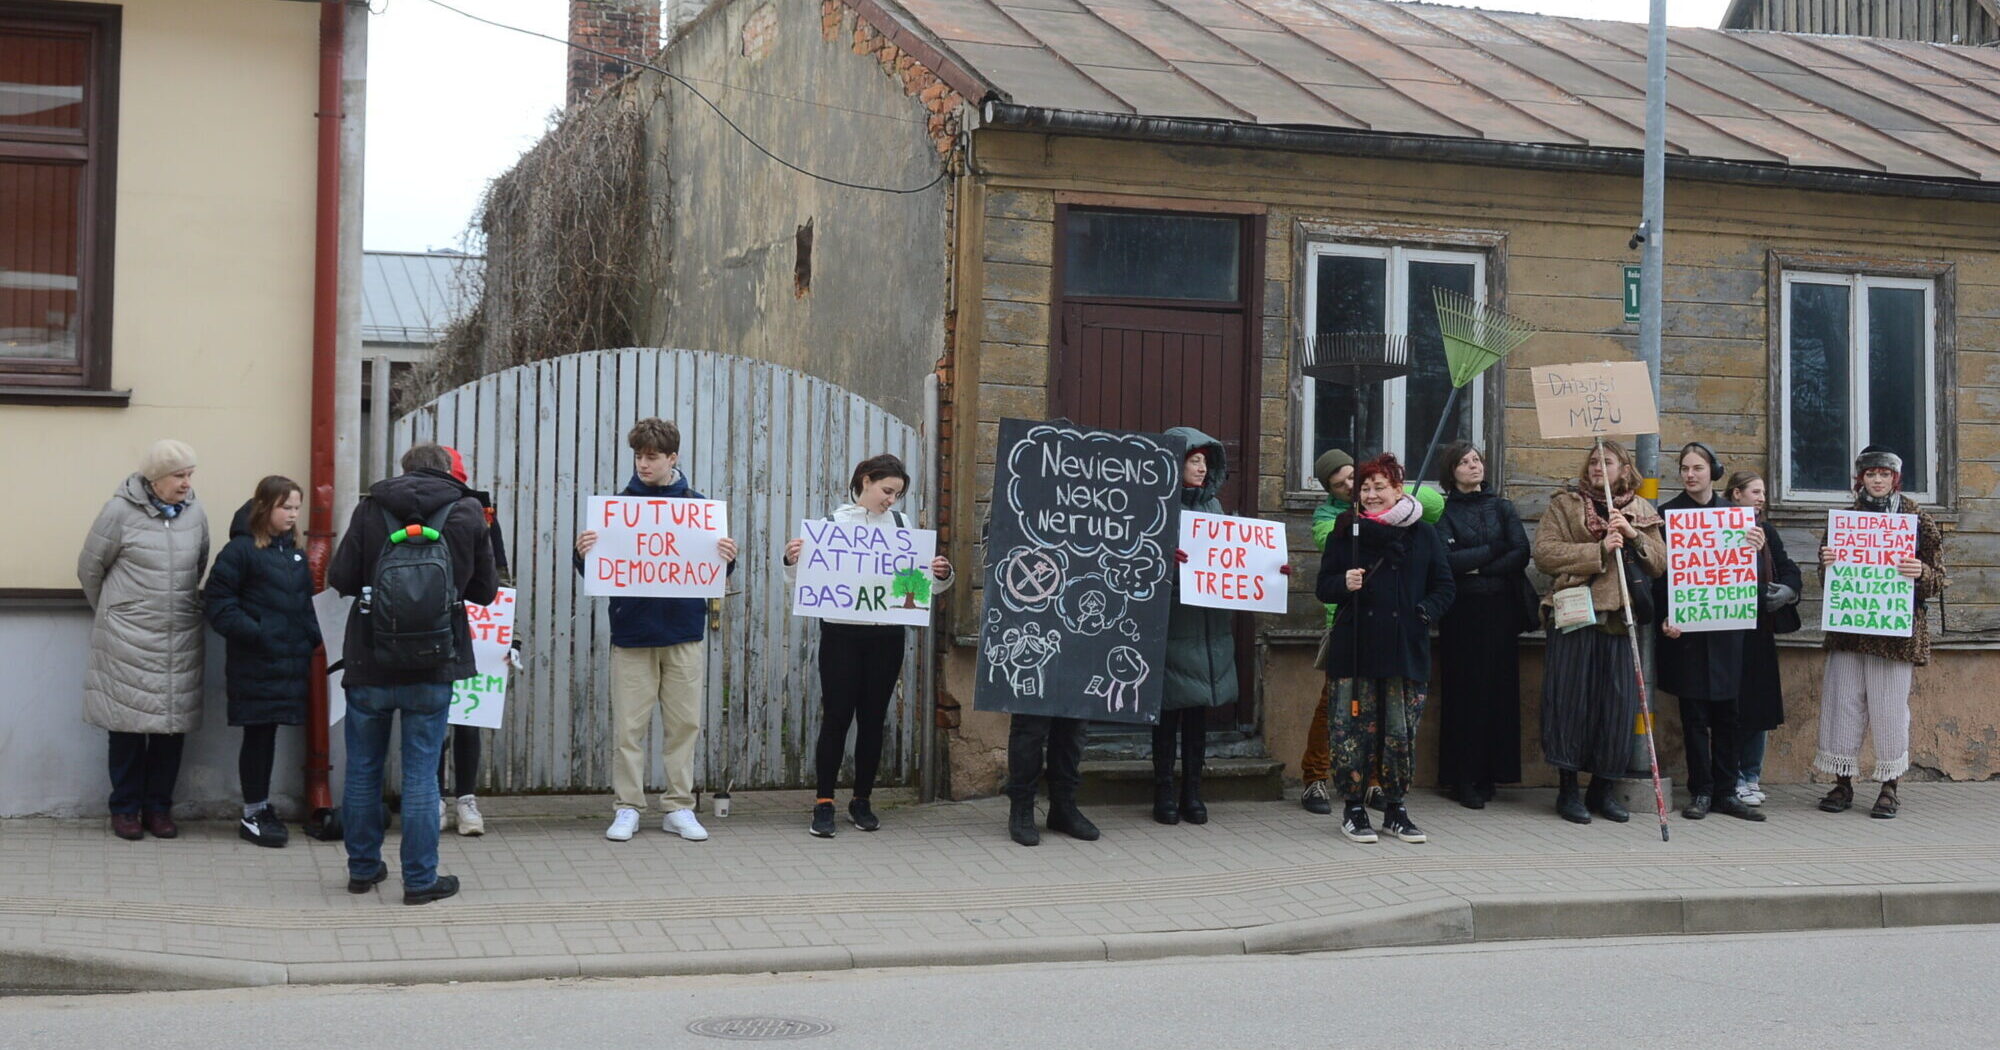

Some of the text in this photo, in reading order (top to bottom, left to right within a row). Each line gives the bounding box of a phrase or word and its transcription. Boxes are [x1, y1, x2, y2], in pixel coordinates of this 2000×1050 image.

[1569, 406, 1622, 432] MIZU
[604, 500, 717, 531] FUTURE
[1669, 507, 1754, 530] KULTŪ-
[1835, 514, 1909, 531] GLOBĀLĀ
[637, 531, 680, 557] FOR
[804, 522, 913, 551] VARAS
[1192, 518, 1277, 550] FUTURE
[1670, 530, 1716, 549] RAS
[1207, 547, 1247, 569] FOR
[598, 557, 721, 588] DEMOCRACY
[1672, 566, 1756, 587] PILSĒTA
[1194, 570, 1265, 601] TREES
[1674, 585, 1757, 603] BEZ DEMO
[1675, 602, 1757, 623] KRĀTIJAS
[1829, 593, 1908, 612] ŠANA IR
[1828, 611, 1912, 631] LABĀKA?
